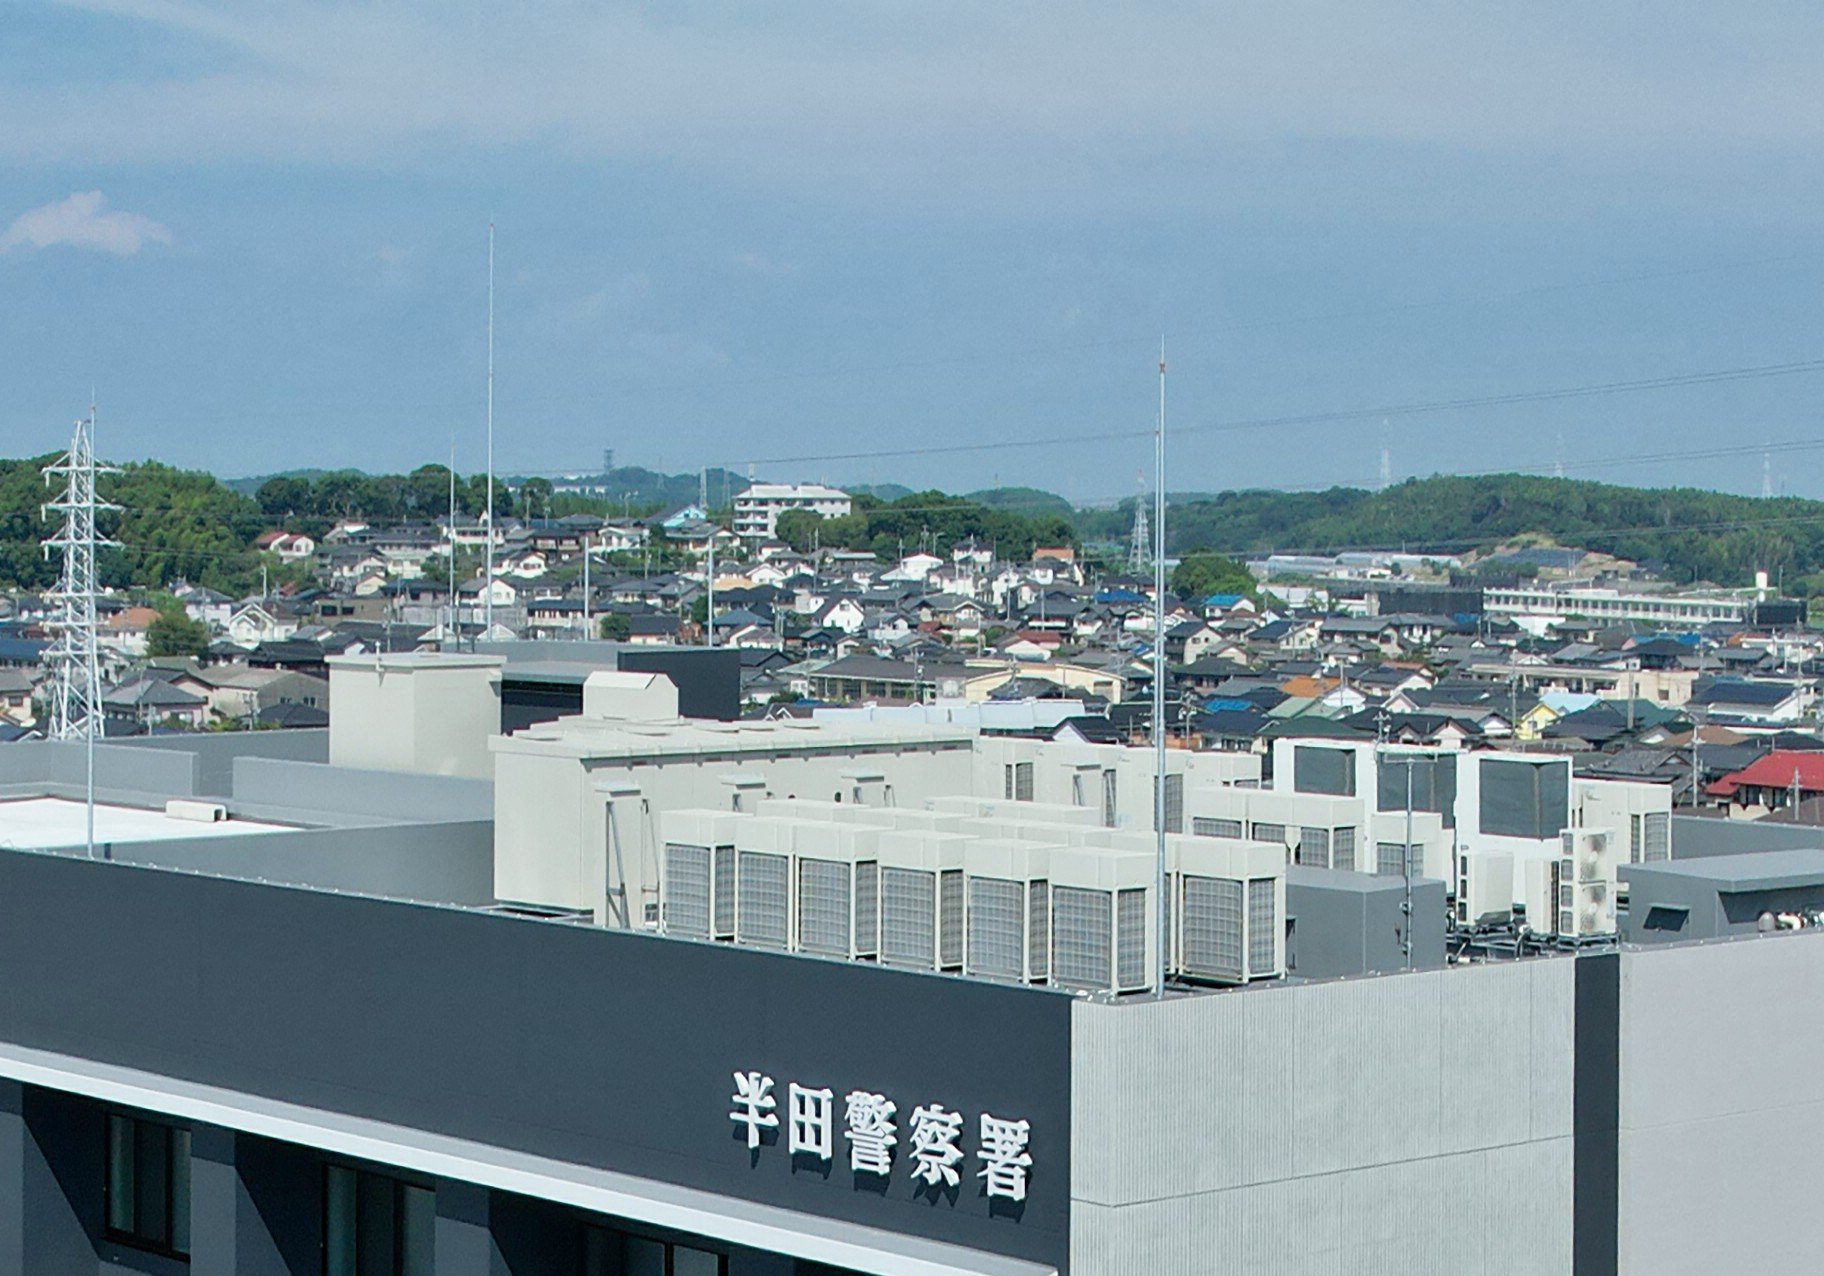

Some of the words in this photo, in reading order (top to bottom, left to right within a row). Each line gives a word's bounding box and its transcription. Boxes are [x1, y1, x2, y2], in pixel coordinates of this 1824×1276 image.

[729, 1071, 1033, 1201] 半田警察署
